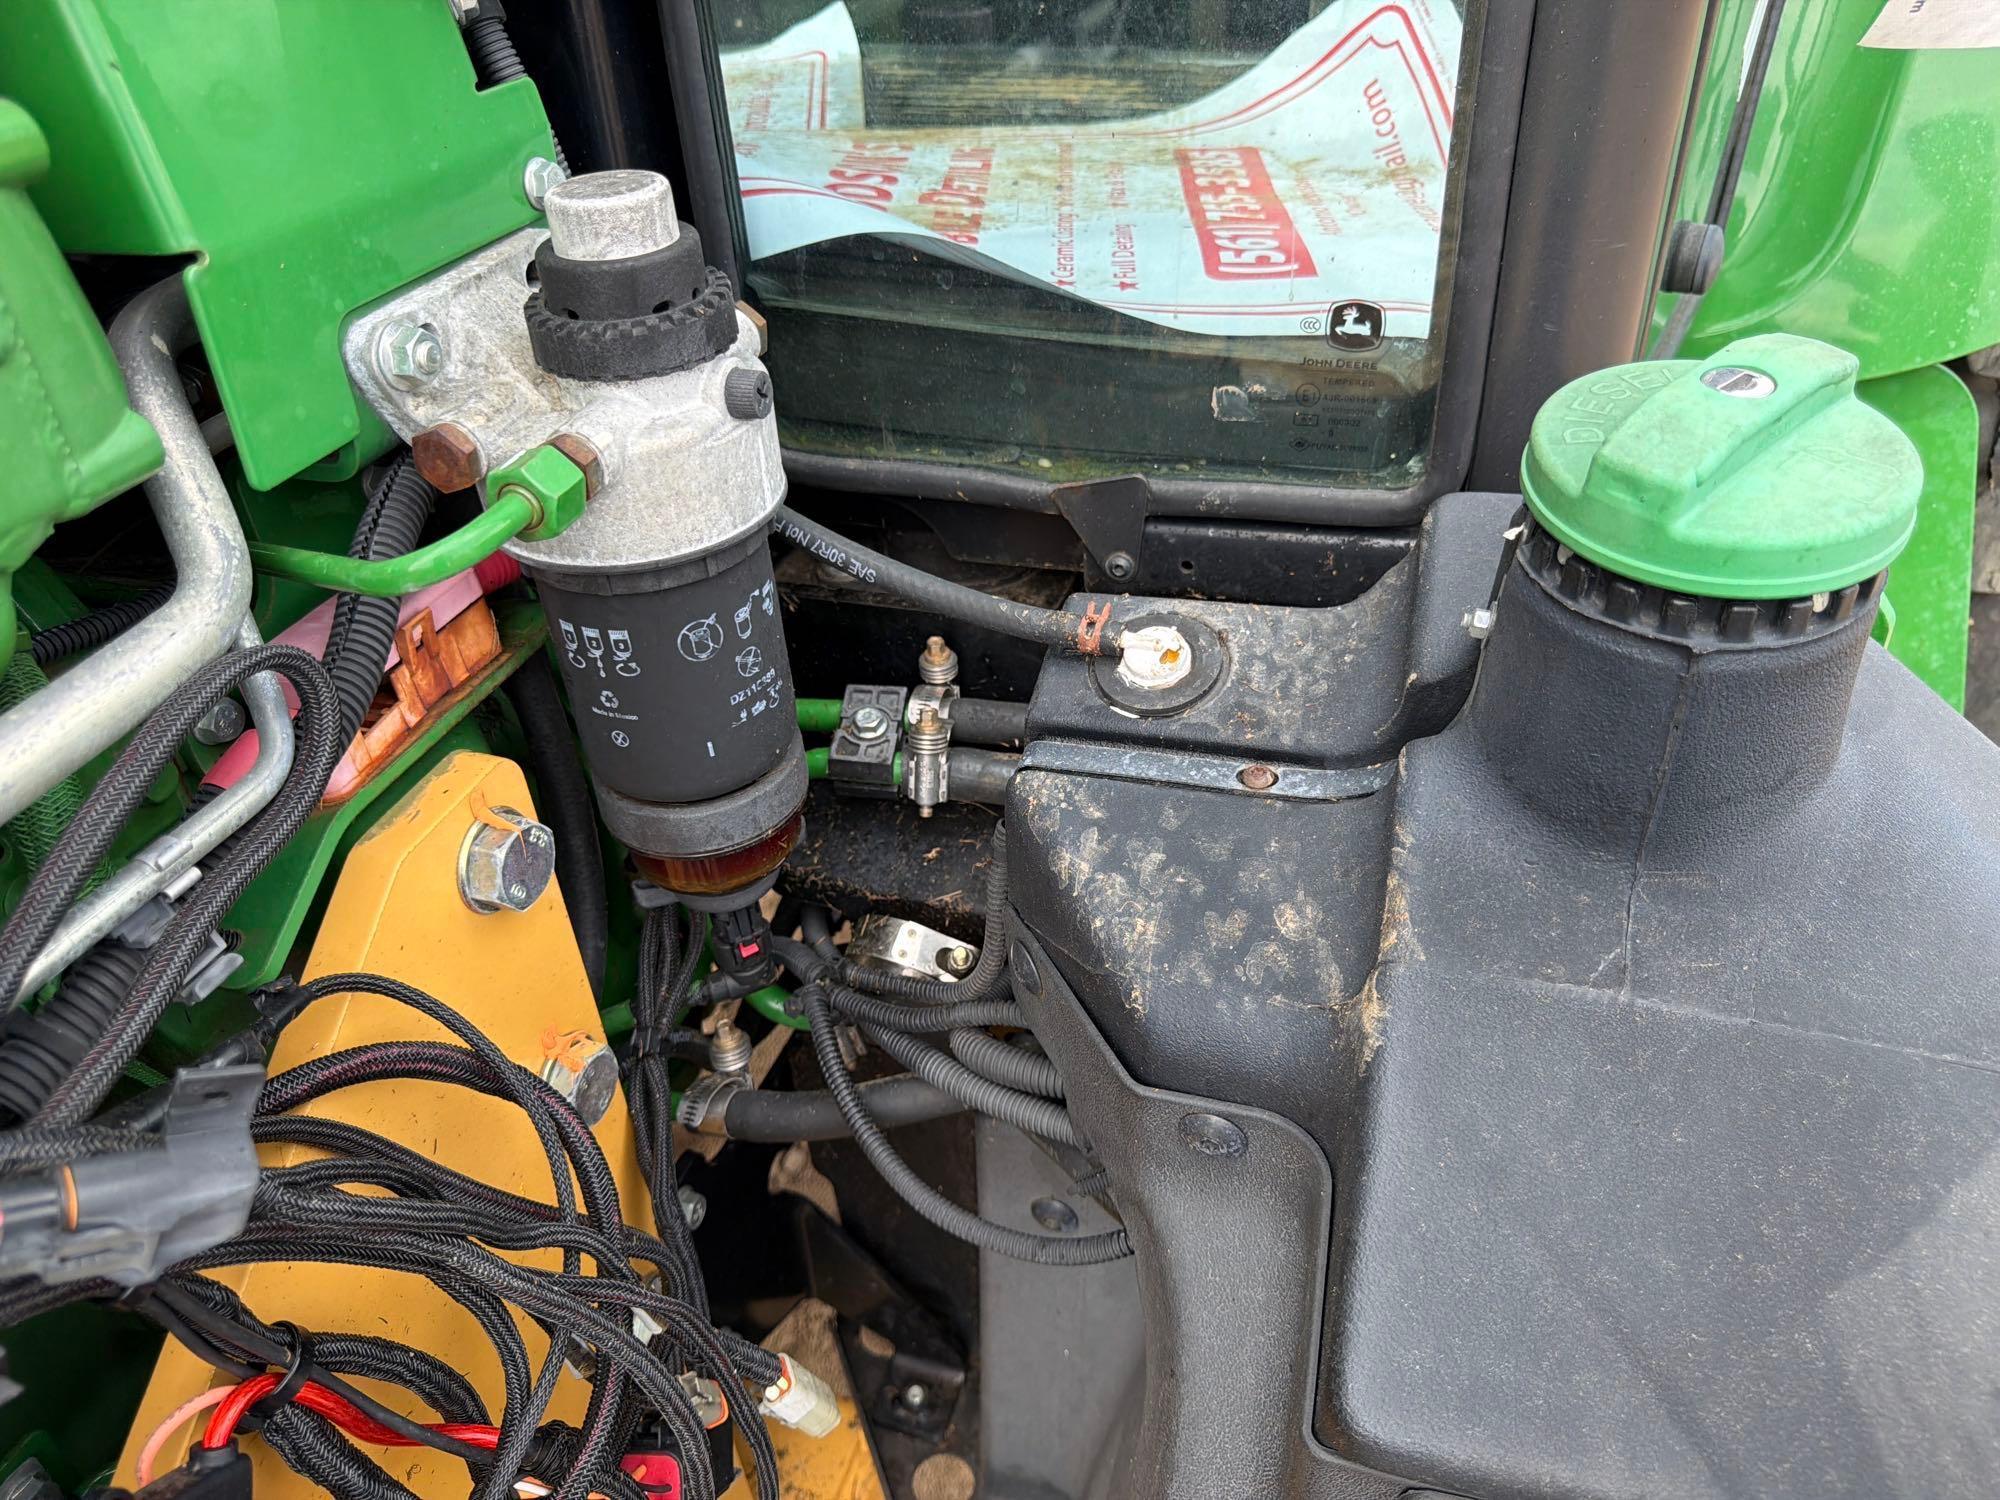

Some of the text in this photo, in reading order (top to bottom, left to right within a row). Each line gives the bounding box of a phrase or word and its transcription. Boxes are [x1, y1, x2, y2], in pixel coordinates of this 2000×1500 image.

[1051, 240, 1075, 278] Ceramic
[1206, 224, 1299, 274] (561)
[1112, 261, 1136, 279] Full
[1300, 357, 1378, 371] JOHN DEERE
[786, 523, 811, 547] Not
[810, 539, 846, 567] 30R7
[847, 557, 877, 584] SAE
